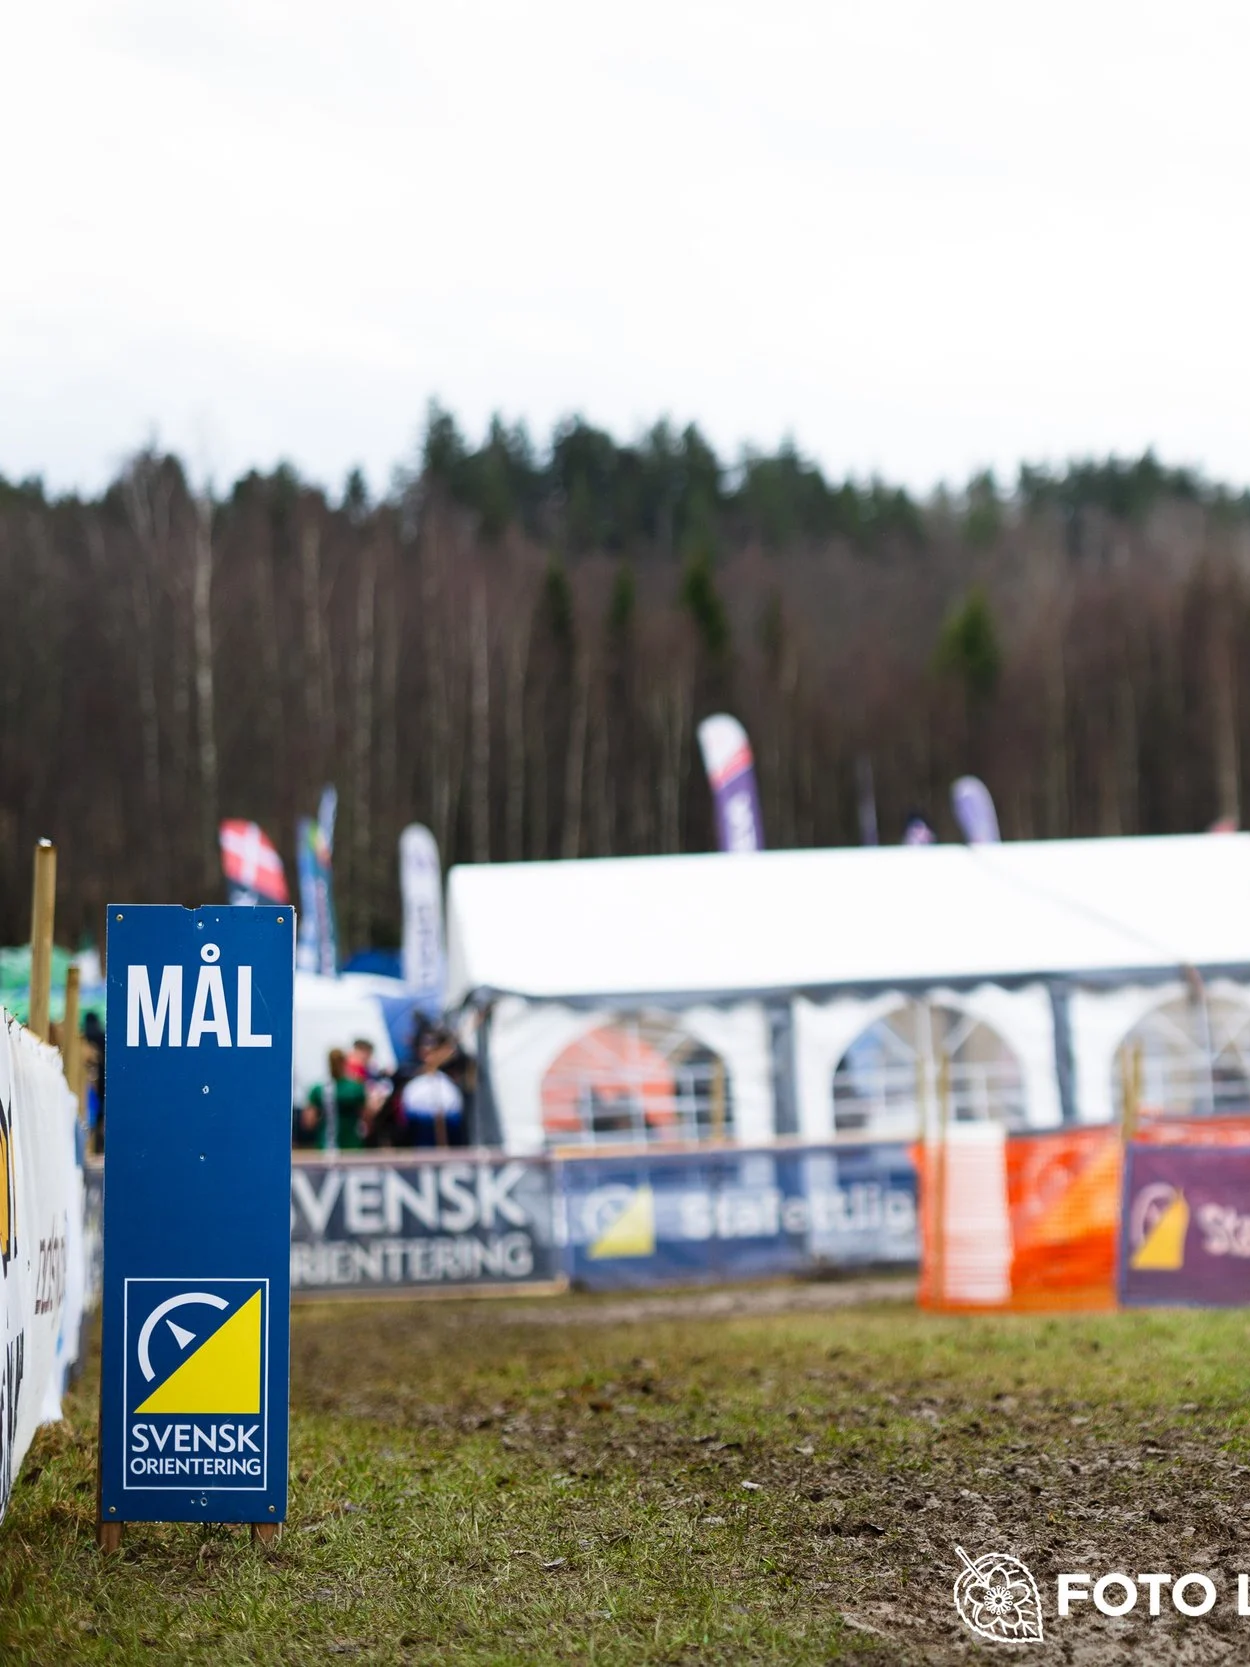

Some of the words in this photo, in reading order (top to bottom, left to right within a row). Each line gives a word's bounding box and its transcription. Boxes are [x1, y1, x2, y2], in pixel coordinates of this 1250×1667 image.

[126, 943, 273, 1048] MÅL
[291, 1162, 528, 1237] VENSK
[290, 1233, 534, 1286] RIENTERING
[131, 1423, 261, 1453] SVENSK
[130, 1457, 262, 1476] ORIENTERING
